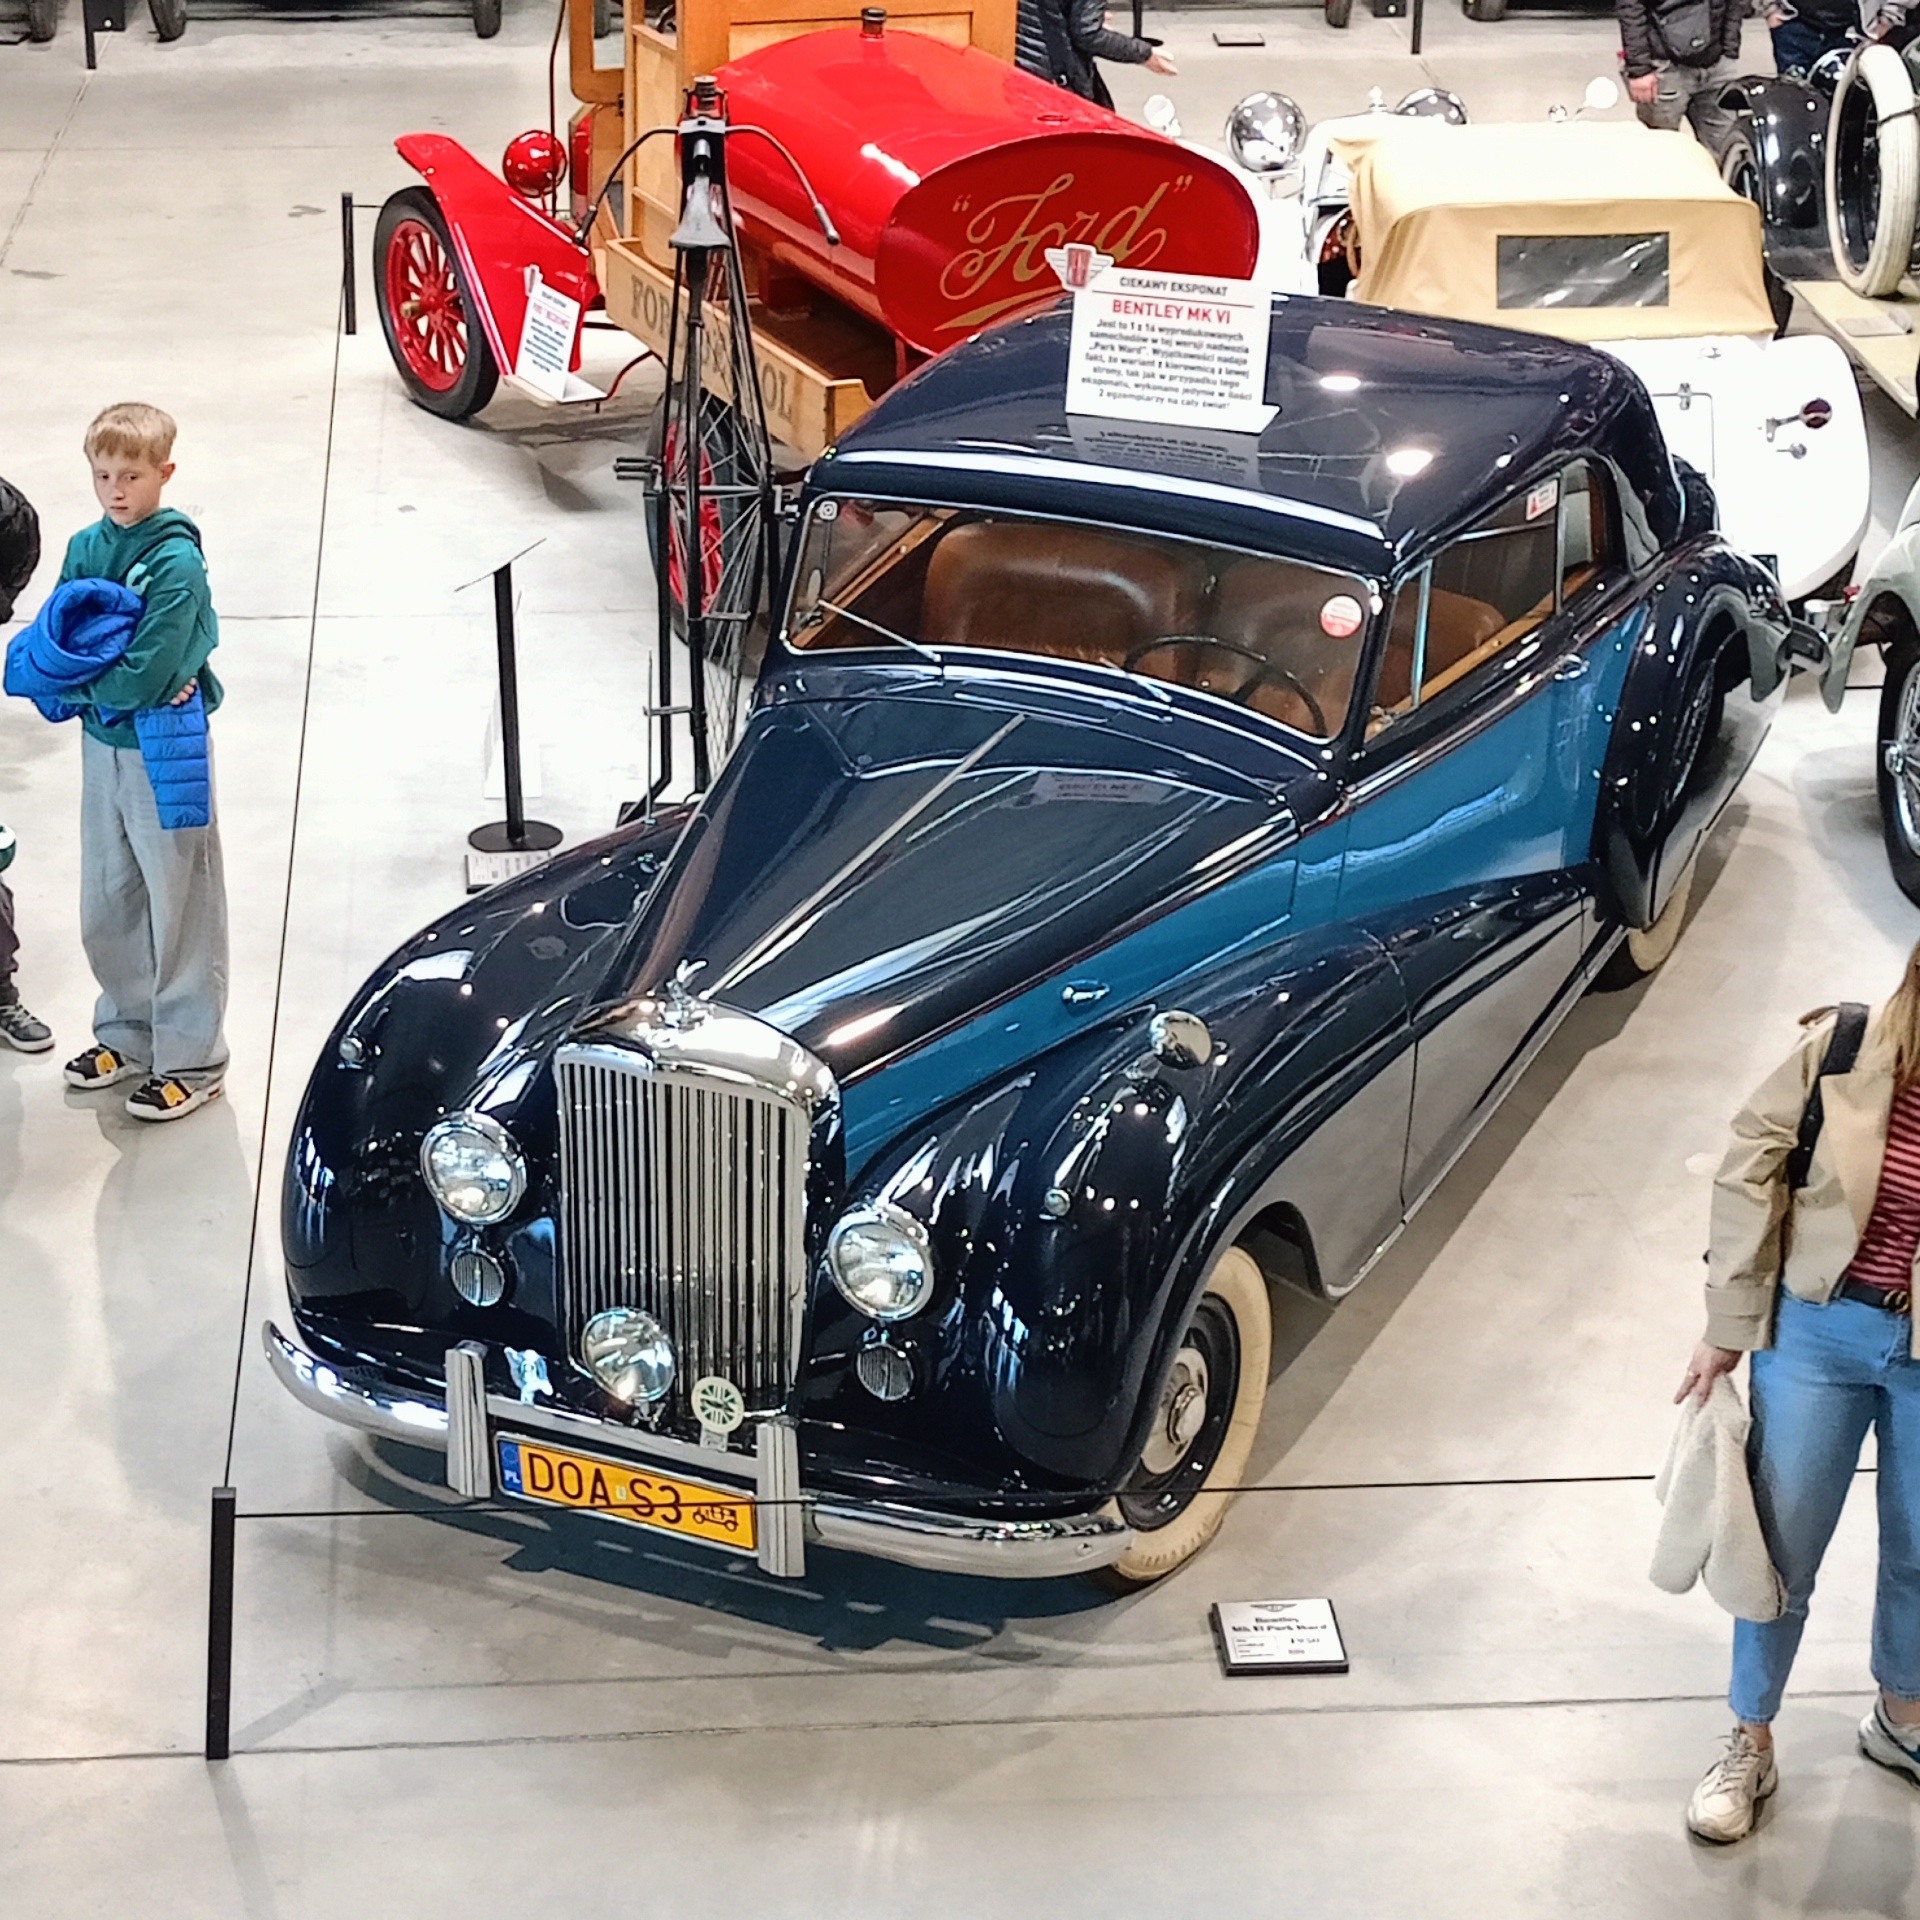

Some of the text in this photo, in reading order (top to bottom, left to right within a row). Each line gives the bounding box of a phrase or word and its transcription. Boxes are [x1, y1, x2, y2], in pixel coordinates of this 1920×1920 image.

[1120, 277, 1228, 296] CIEKAWY EKSPONAT
[1113, 299, 1230, 324] BENTLEY MK VI
[1118, 321, 1127, 329] to
[504, 1470, 521, 1484] PL
[528, 1453, 682, 1524] DOA S3
